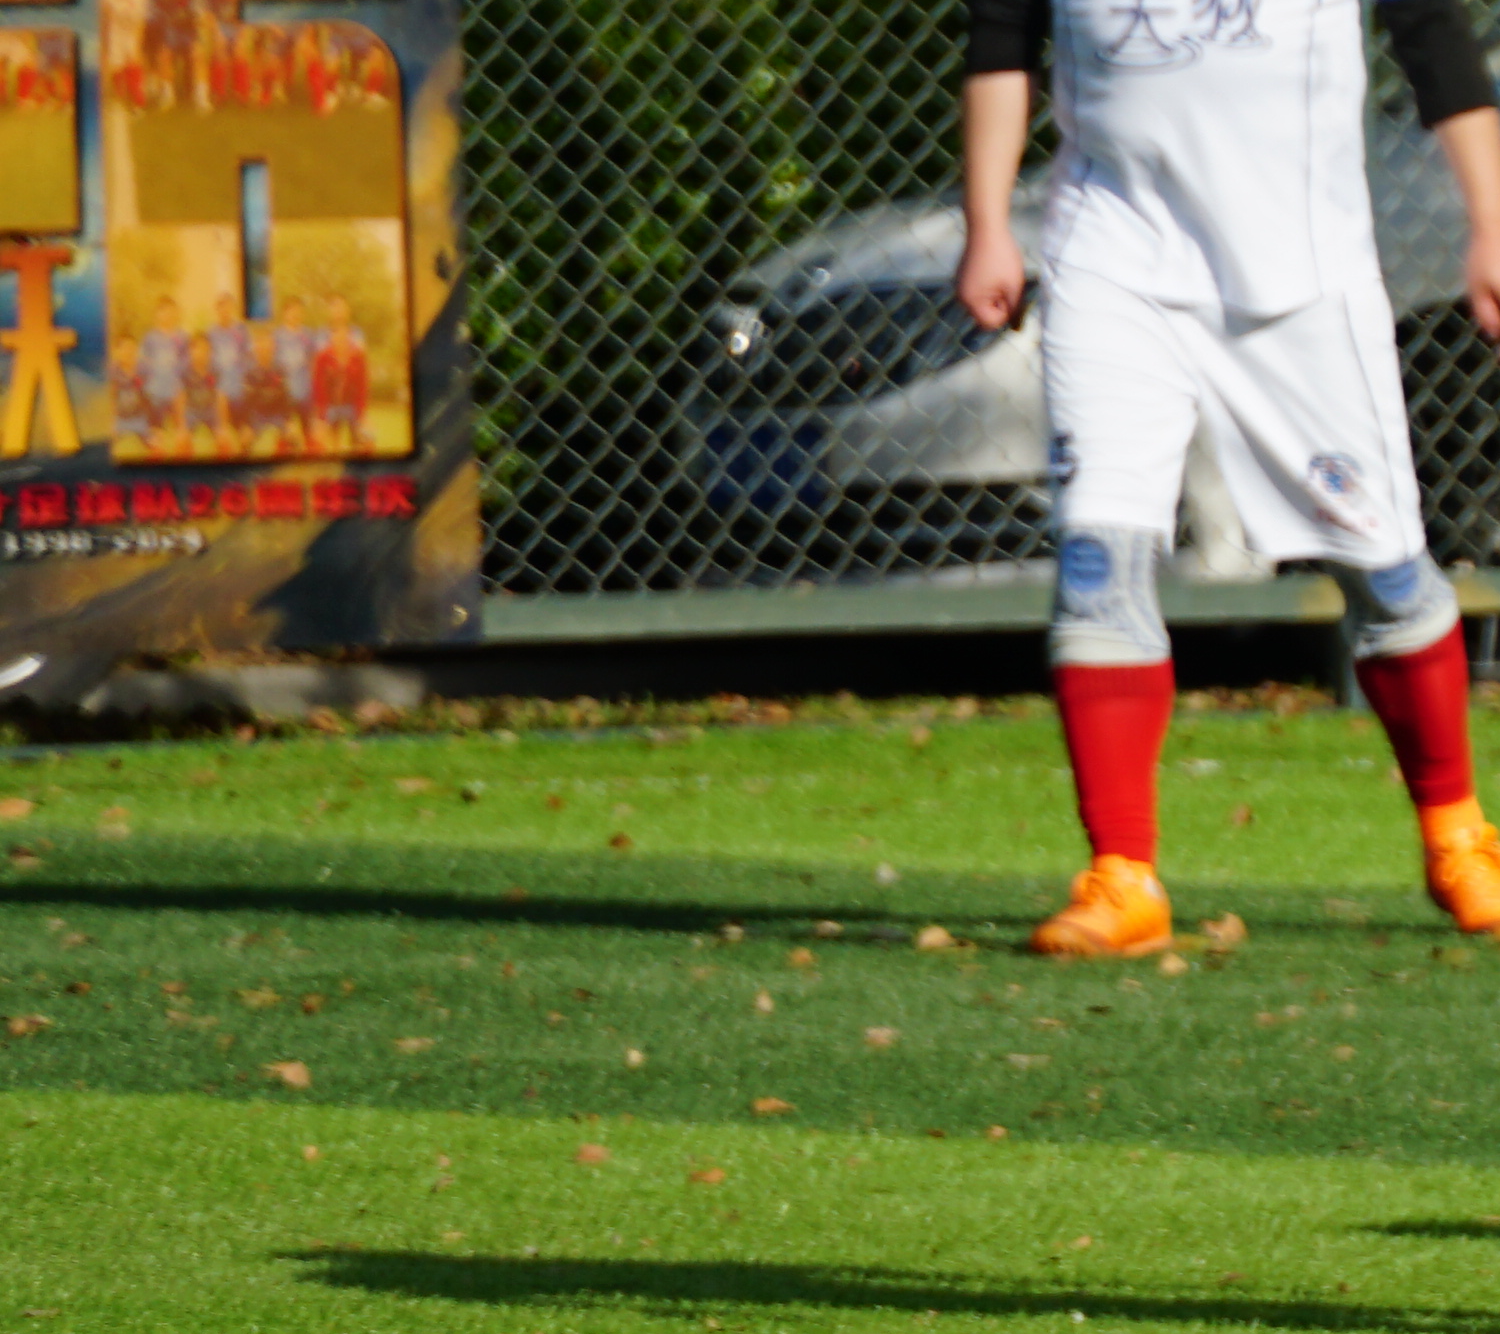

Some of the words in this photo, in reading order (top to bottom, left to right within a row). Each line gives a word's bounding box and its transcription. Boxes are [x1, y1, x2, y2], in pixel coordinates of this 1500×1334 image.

[0, 474, 418, 529] 足球队26周年庆
